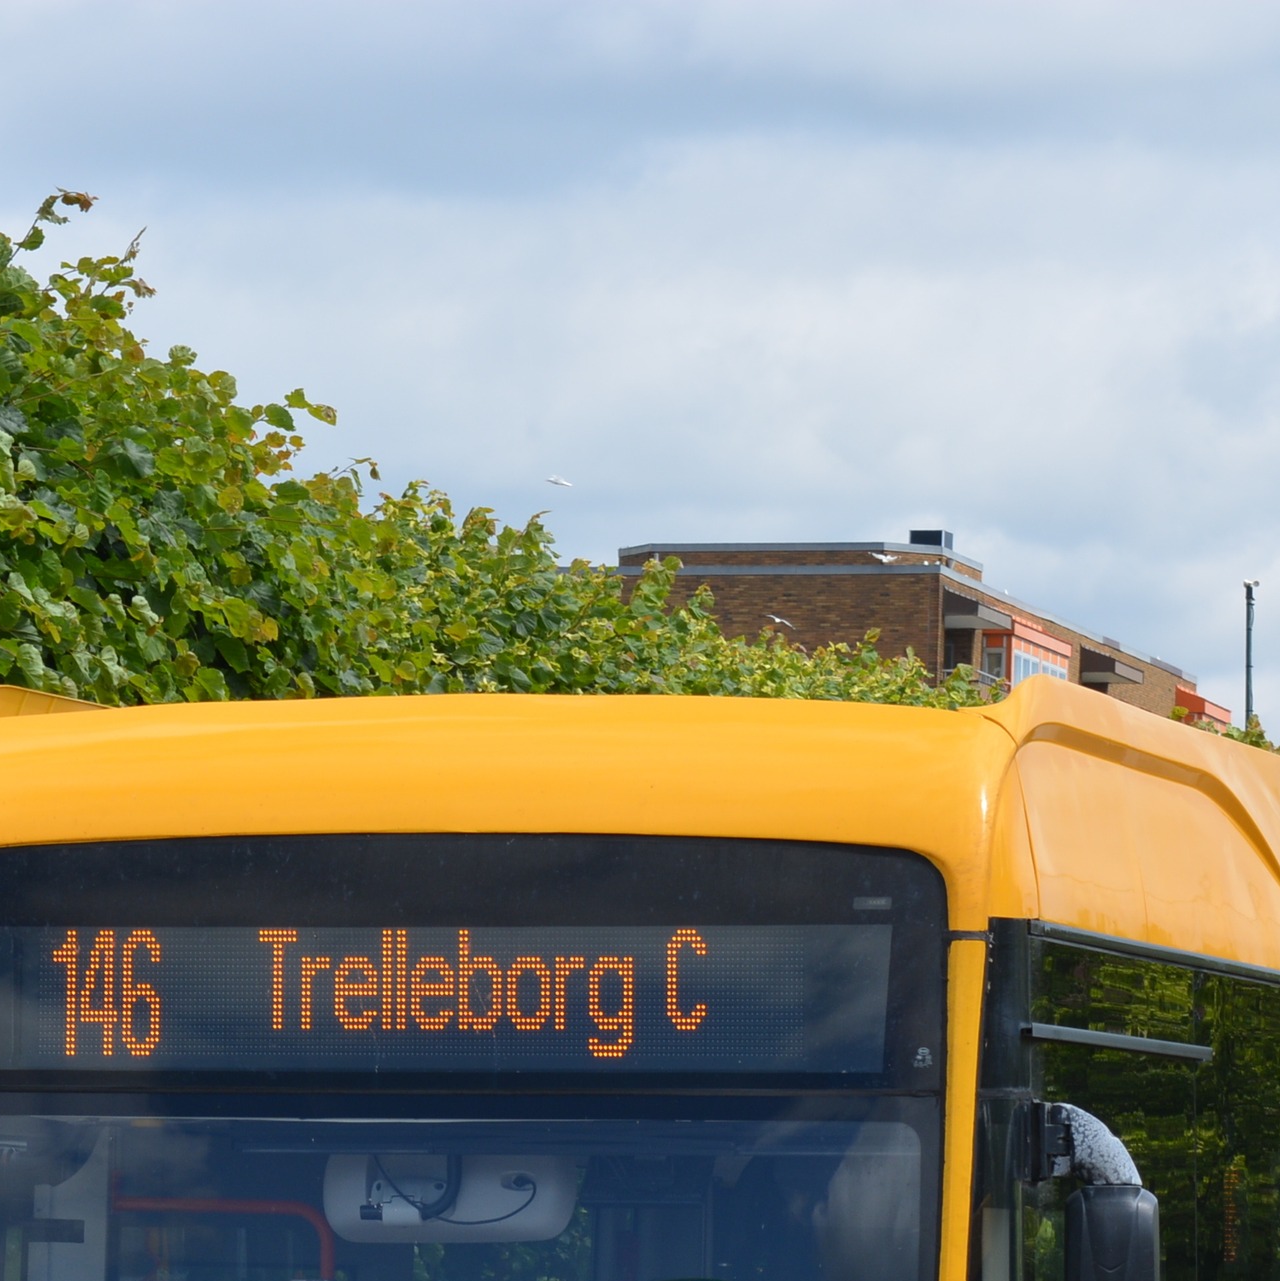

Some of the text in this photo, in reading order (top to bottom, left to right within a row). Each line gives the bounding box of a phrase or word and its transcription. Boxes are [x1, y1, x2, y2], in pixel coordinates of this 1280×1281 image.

[51, 926, 707, 1058] 146 Trelleborg C
